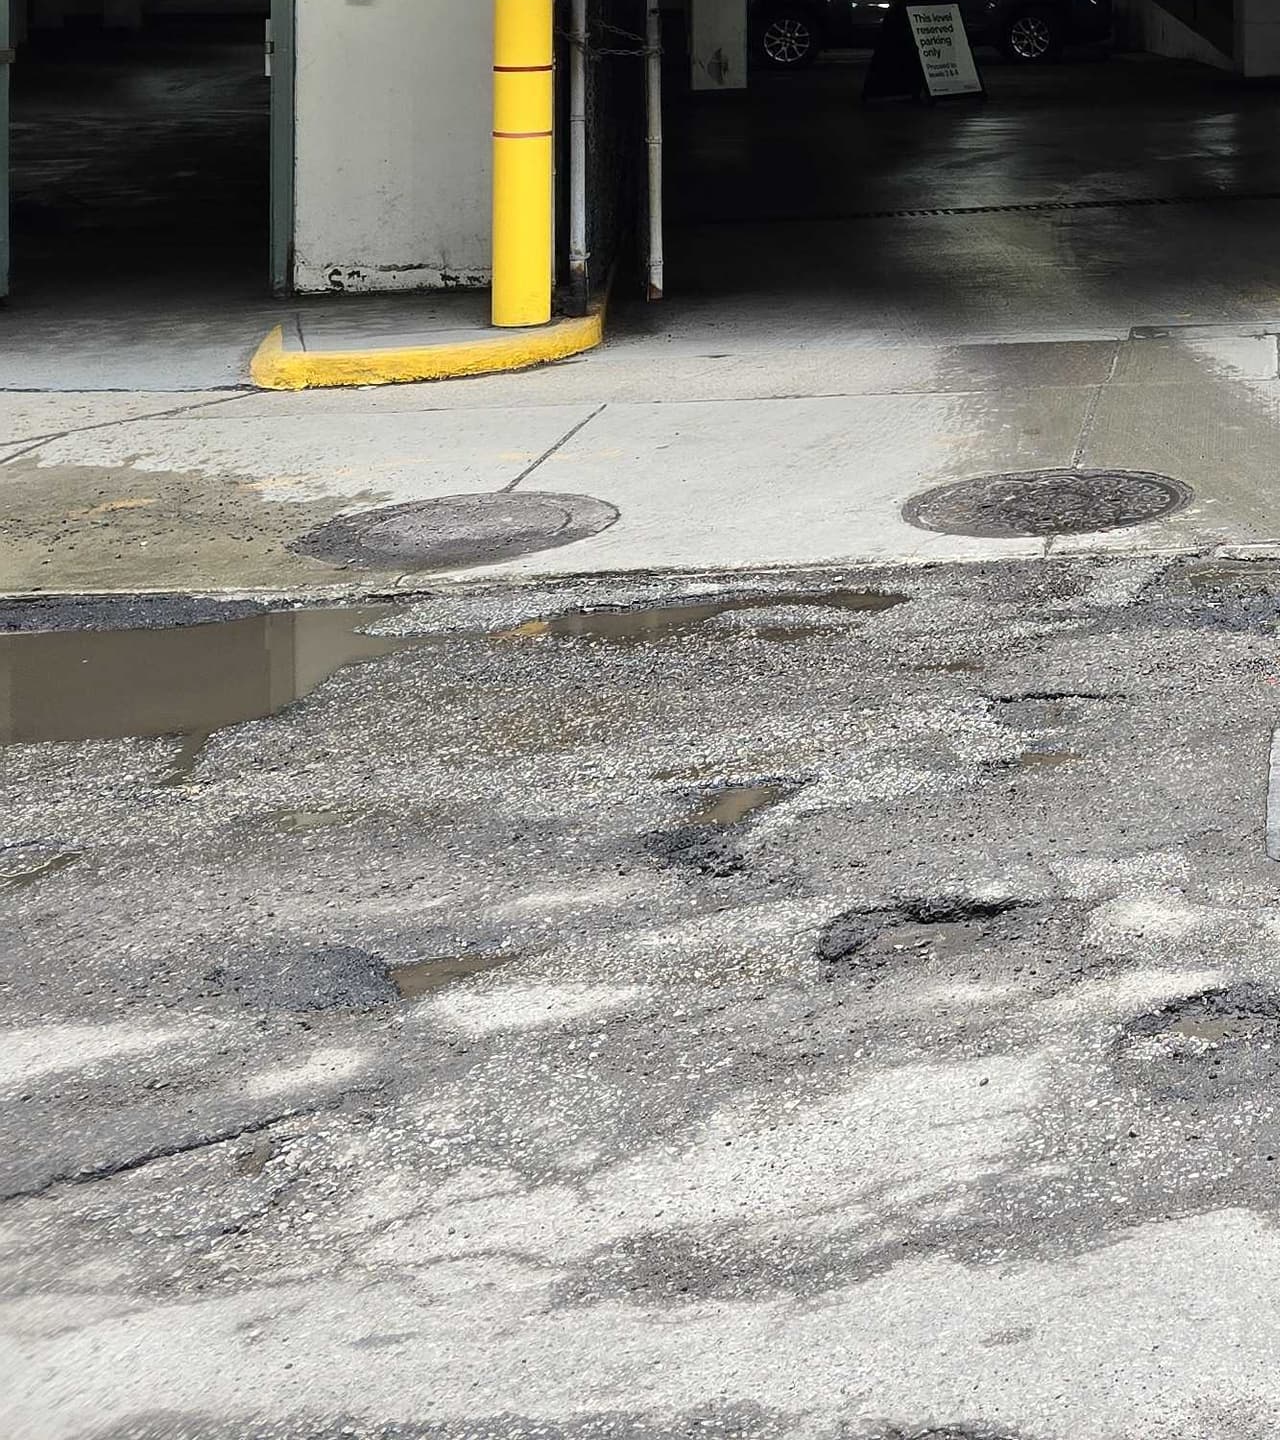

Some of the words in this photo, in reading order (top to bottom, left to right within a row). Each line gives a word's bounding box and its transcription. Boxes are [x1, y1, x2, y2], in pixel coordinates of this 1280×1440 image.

[913, 13, 931, 23] This
[931, 12, 953, 22] level
[916, 24, 954, 34] reserved
[920, 37, 952, 48] parking
[923, 48, 941, 58] only
